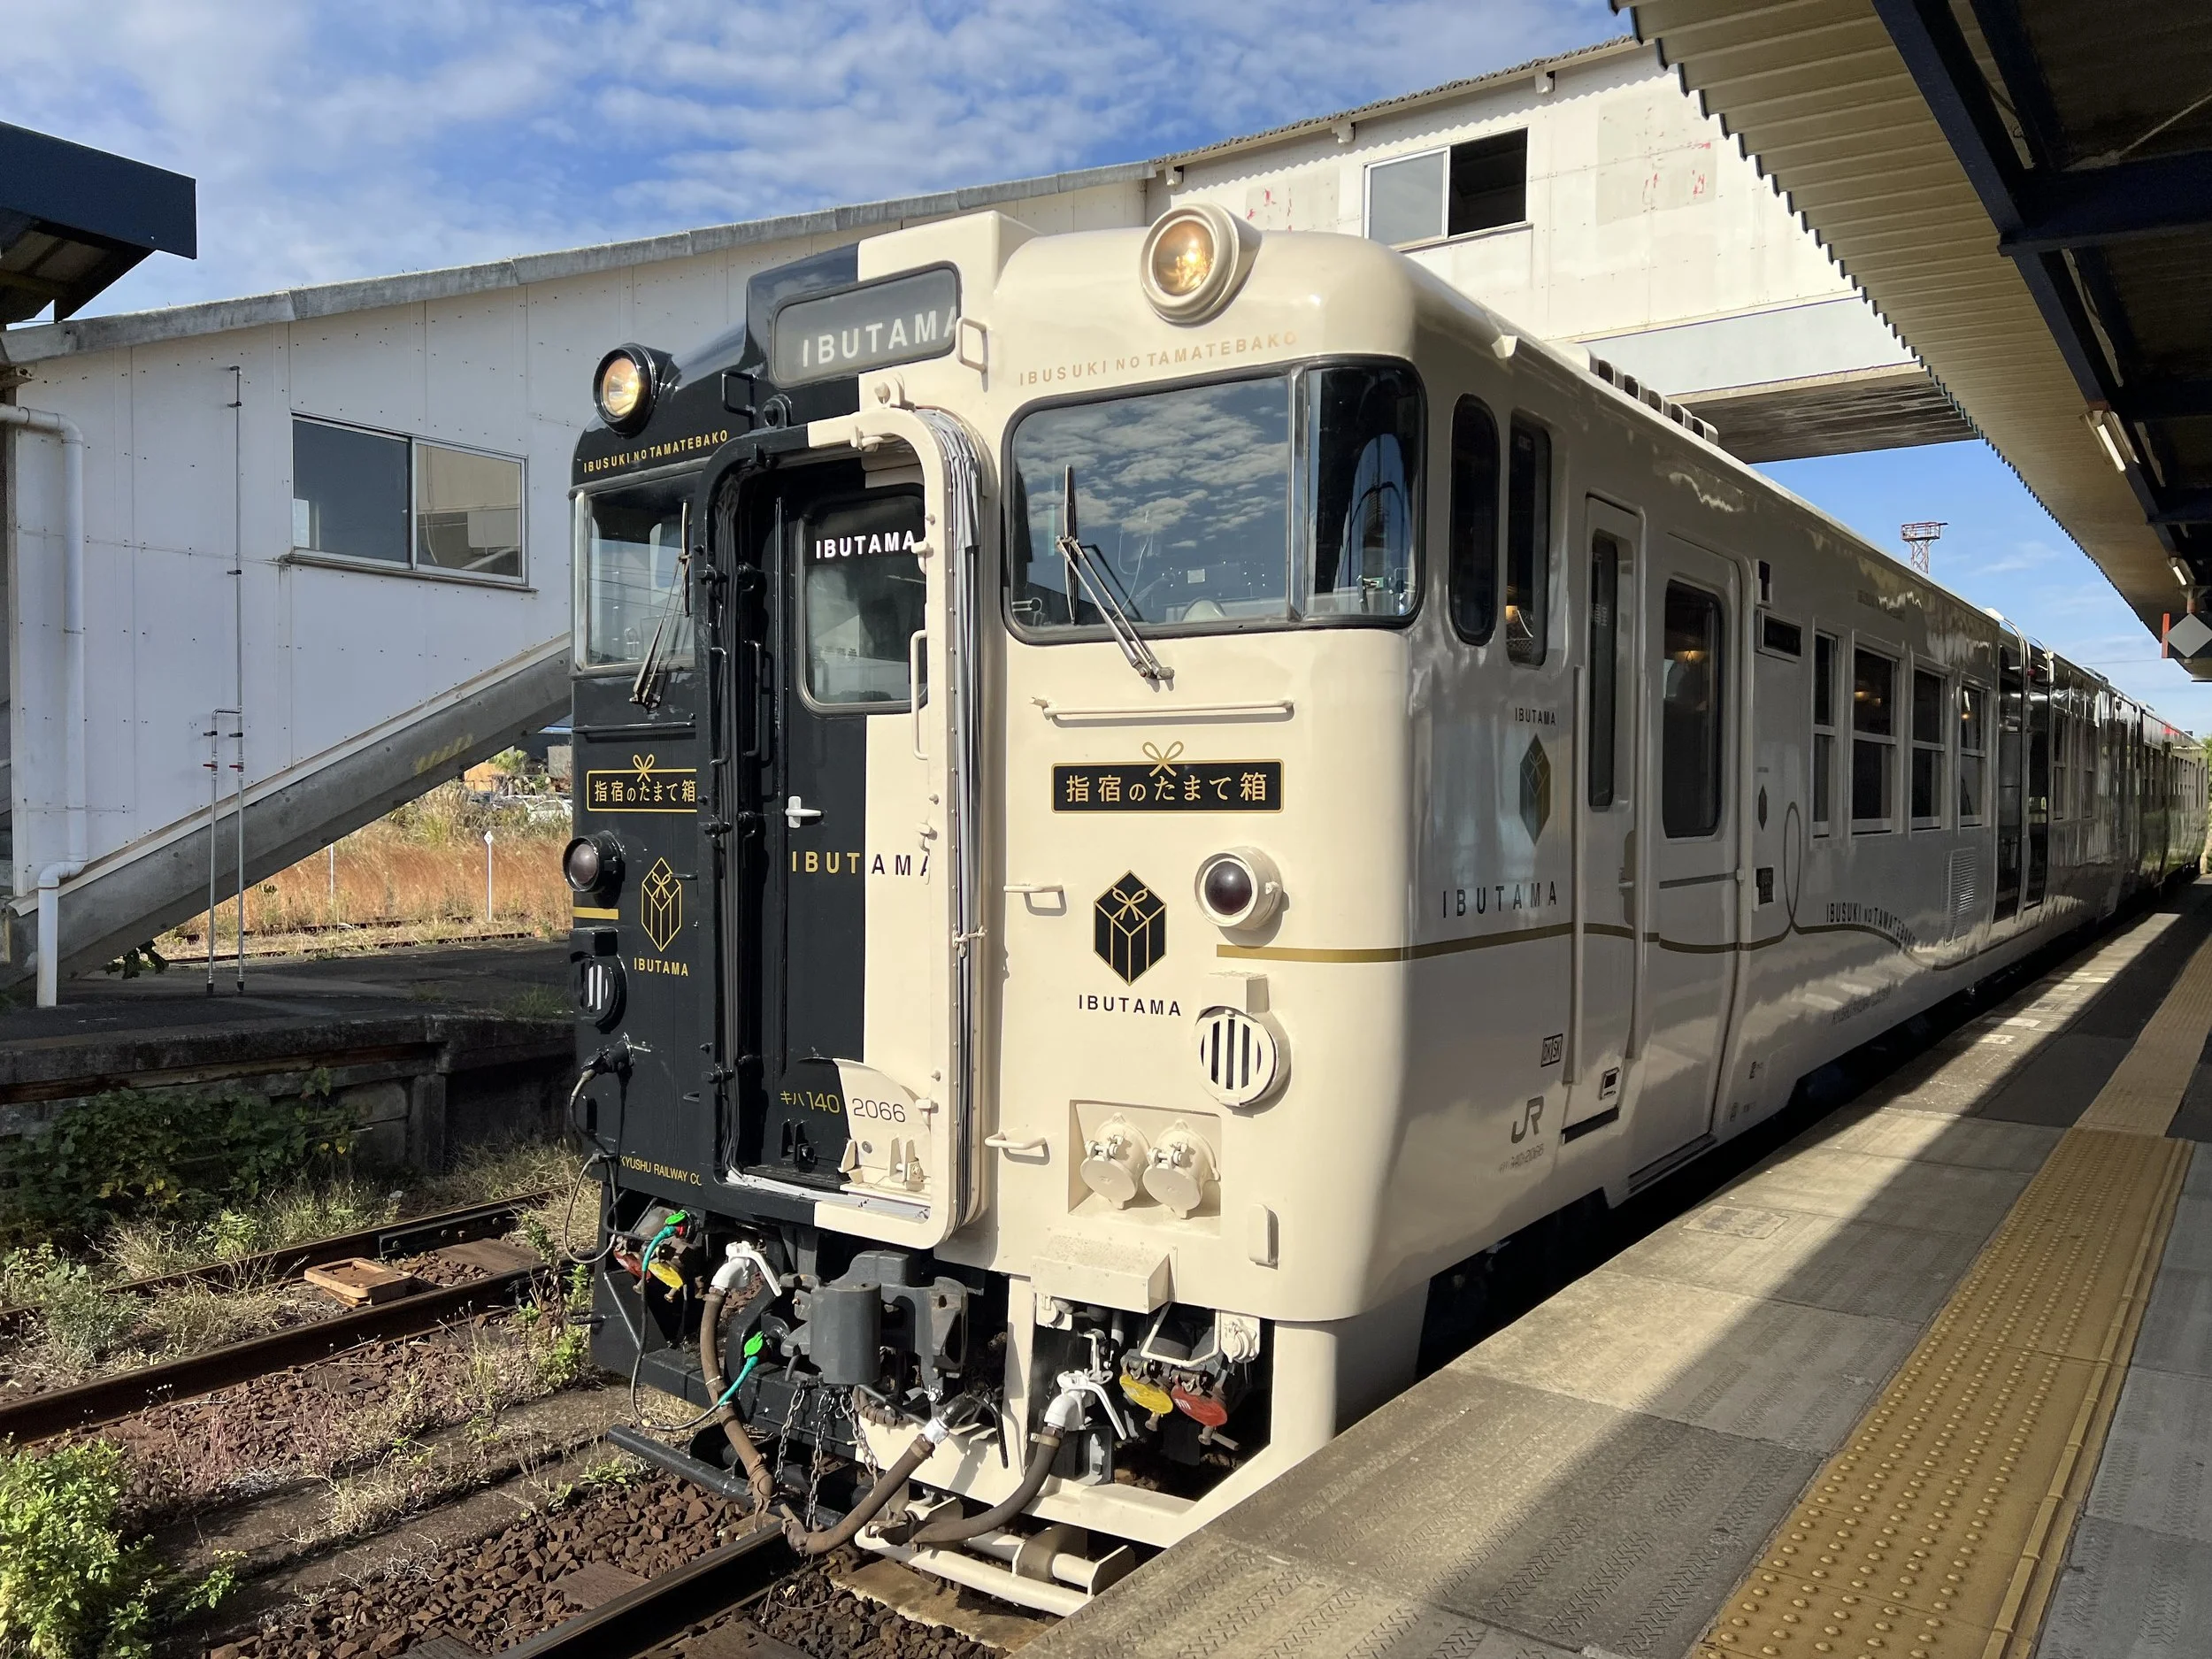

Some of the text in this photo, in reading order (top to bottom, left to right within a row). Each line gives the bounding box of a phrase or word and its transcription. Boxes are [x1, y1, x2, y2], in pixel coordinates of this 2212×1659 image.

[1019, 331, 1297, 386] IBUSUKI NO TAMATEBAKO
[583, 429, 728, 473] IBUSUKI NO TAMATEBAKO
[816, 530, 915, 559] IBUTAMA
[1515, 708, 1555, 726] IBUTAMA
[595, 779, 696, 803] 指宿のたまて箱
[1066, 772, 1267, 803] 指宿のたまて箱
[1442, 880, 1557, 918] IBUTAMA
[1826, 902, 1862, 923] IBUSUKI
[634, 957, 688, 976] IBUTAMA
[1079, 994, 1181, 1017] IBUTAMA
[852, 1098, 906, 1123] 2066
[1511, 1095, 1544, 1144] JR
[654, 1164, 687, 1182] RAILWAY
